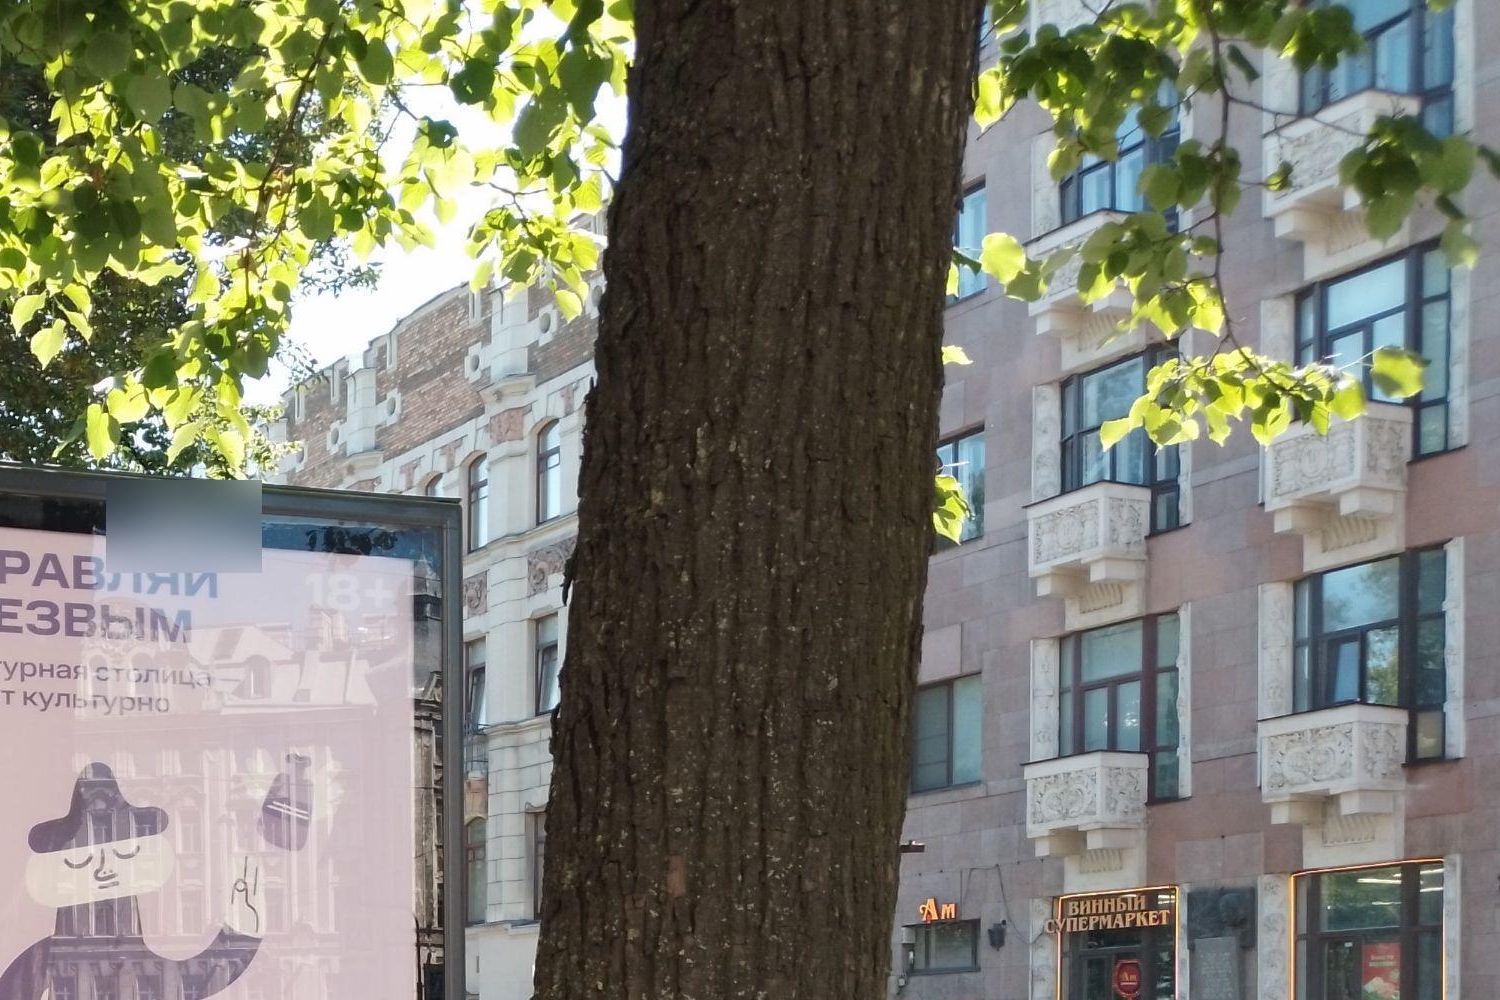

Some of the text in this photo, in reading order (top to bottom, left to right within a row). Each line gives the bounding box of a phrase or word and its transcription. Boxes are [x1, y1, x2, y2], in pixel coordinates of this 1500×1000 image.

[305, 572, 394, 611] 18+
[95, 665, 212, 688] столица
[23, 690, 170, 716] культурно
[1068, 895, 1146, 917] ВИННЫЙ
[1044, 909, 1171, 934] СУПЕРМАРКЕТ
